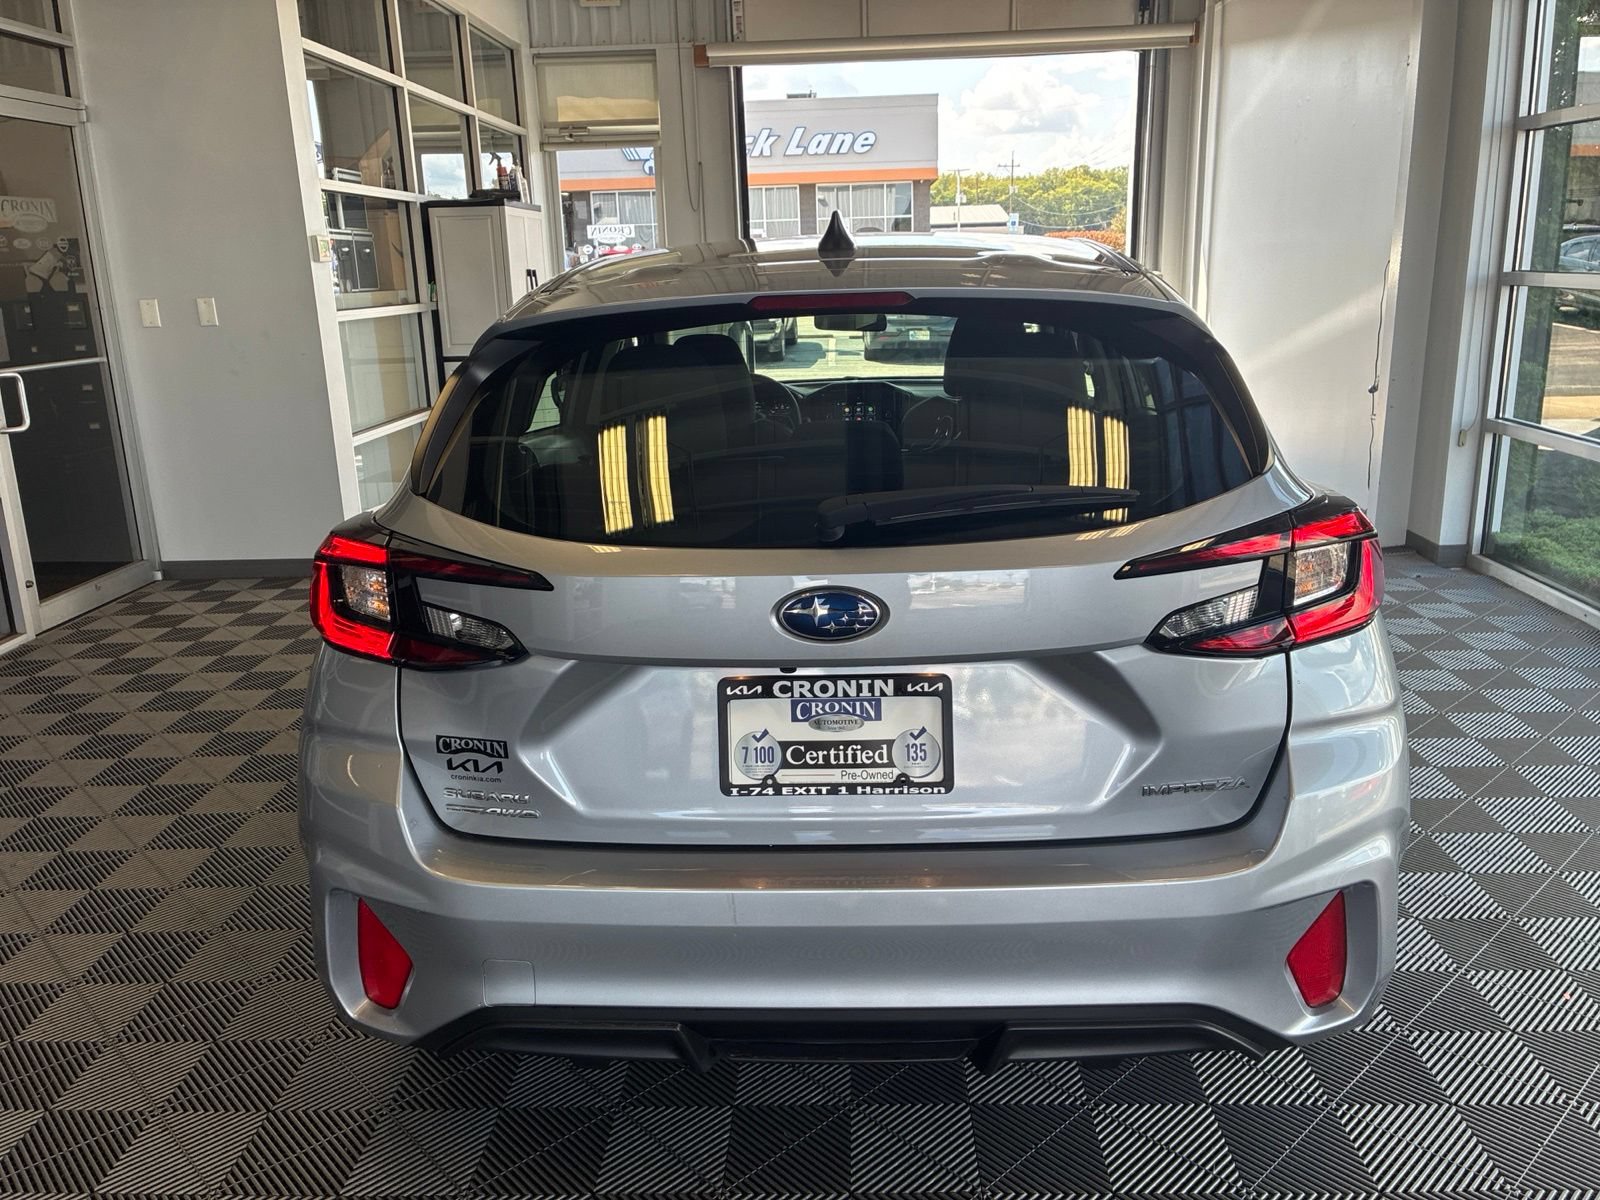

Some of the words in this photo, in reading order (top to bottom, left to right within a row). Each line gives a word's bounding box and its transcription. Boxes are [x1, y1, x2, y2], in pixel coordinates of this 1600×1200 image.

[784, 126, 877, 157] Lane
[772, 679, 894, 698] CRONIN
[796, 701, 876, 720] CRONIN
[439, 737, 504, 757] CRONIN
[741, 746, 749, 764] 7
[753, 746, 775, 764] 100
[785, 744, 889, 765] Certified
[905, 743, 927, 762] 135
[450, 773, 502, 783] croninkia.com
[840, 770, 894, 780] Pre-Owned
[443, 787, 530, 804] SUBARU
[730, 787, 775, 796] I-74
[781, 786, 831, 795] EXIT
[838, 786, 849, 795] 1
[856, 785, 946, 795] Harrison
[1141, 776, 1250, 796] IMPREZA
[484, 807, 541, 819] AWD
